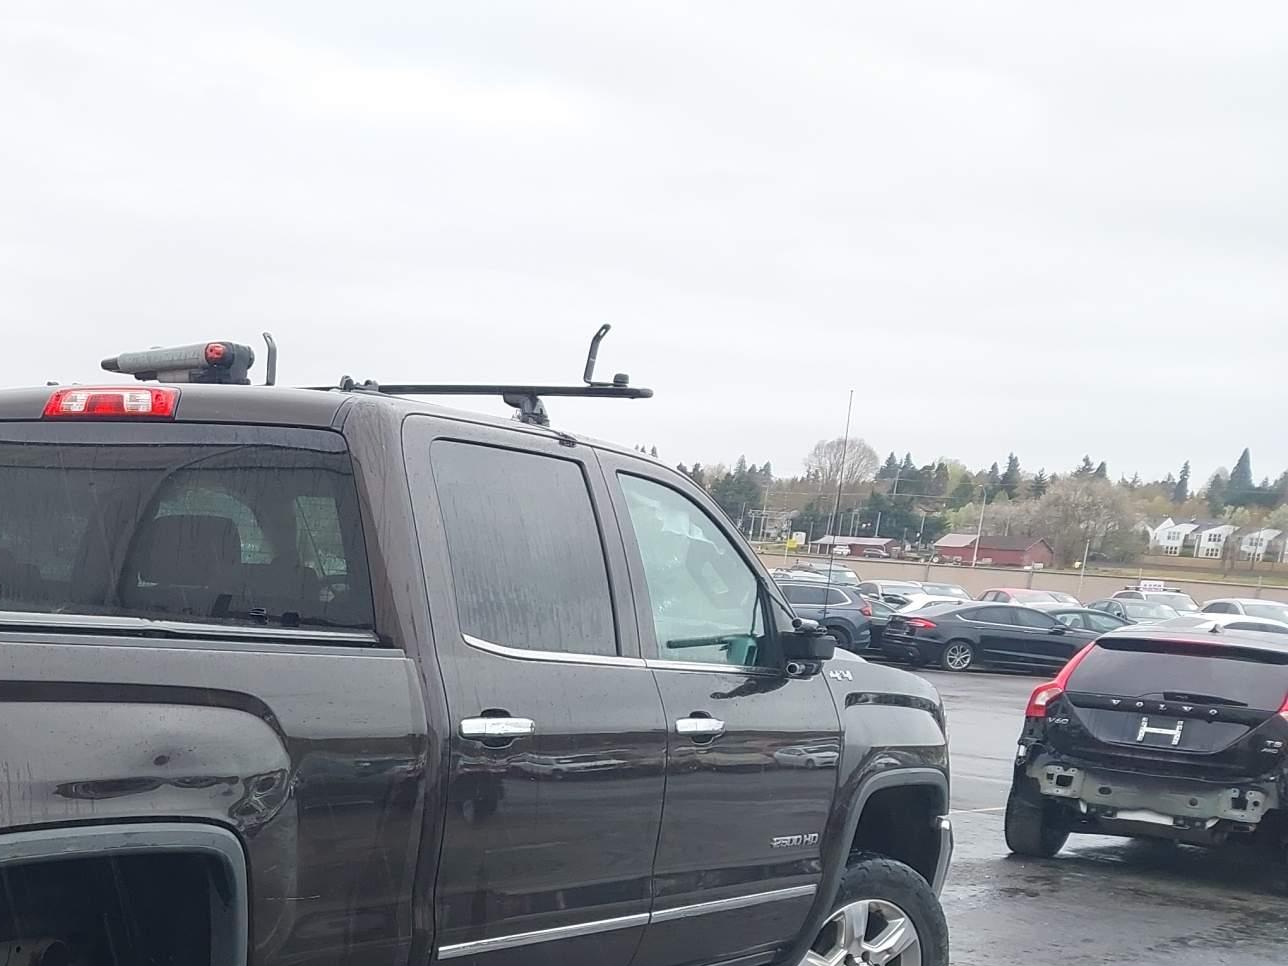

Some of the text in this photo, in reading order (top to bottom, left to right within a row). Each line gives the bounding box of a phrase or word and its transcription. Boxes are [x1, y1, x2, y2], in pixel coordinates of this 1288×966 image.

[1111, 698, 1219, 717] VOLVO
[1047, 716, 1070, 725] V60
[802, 832, 819, 846] HD
